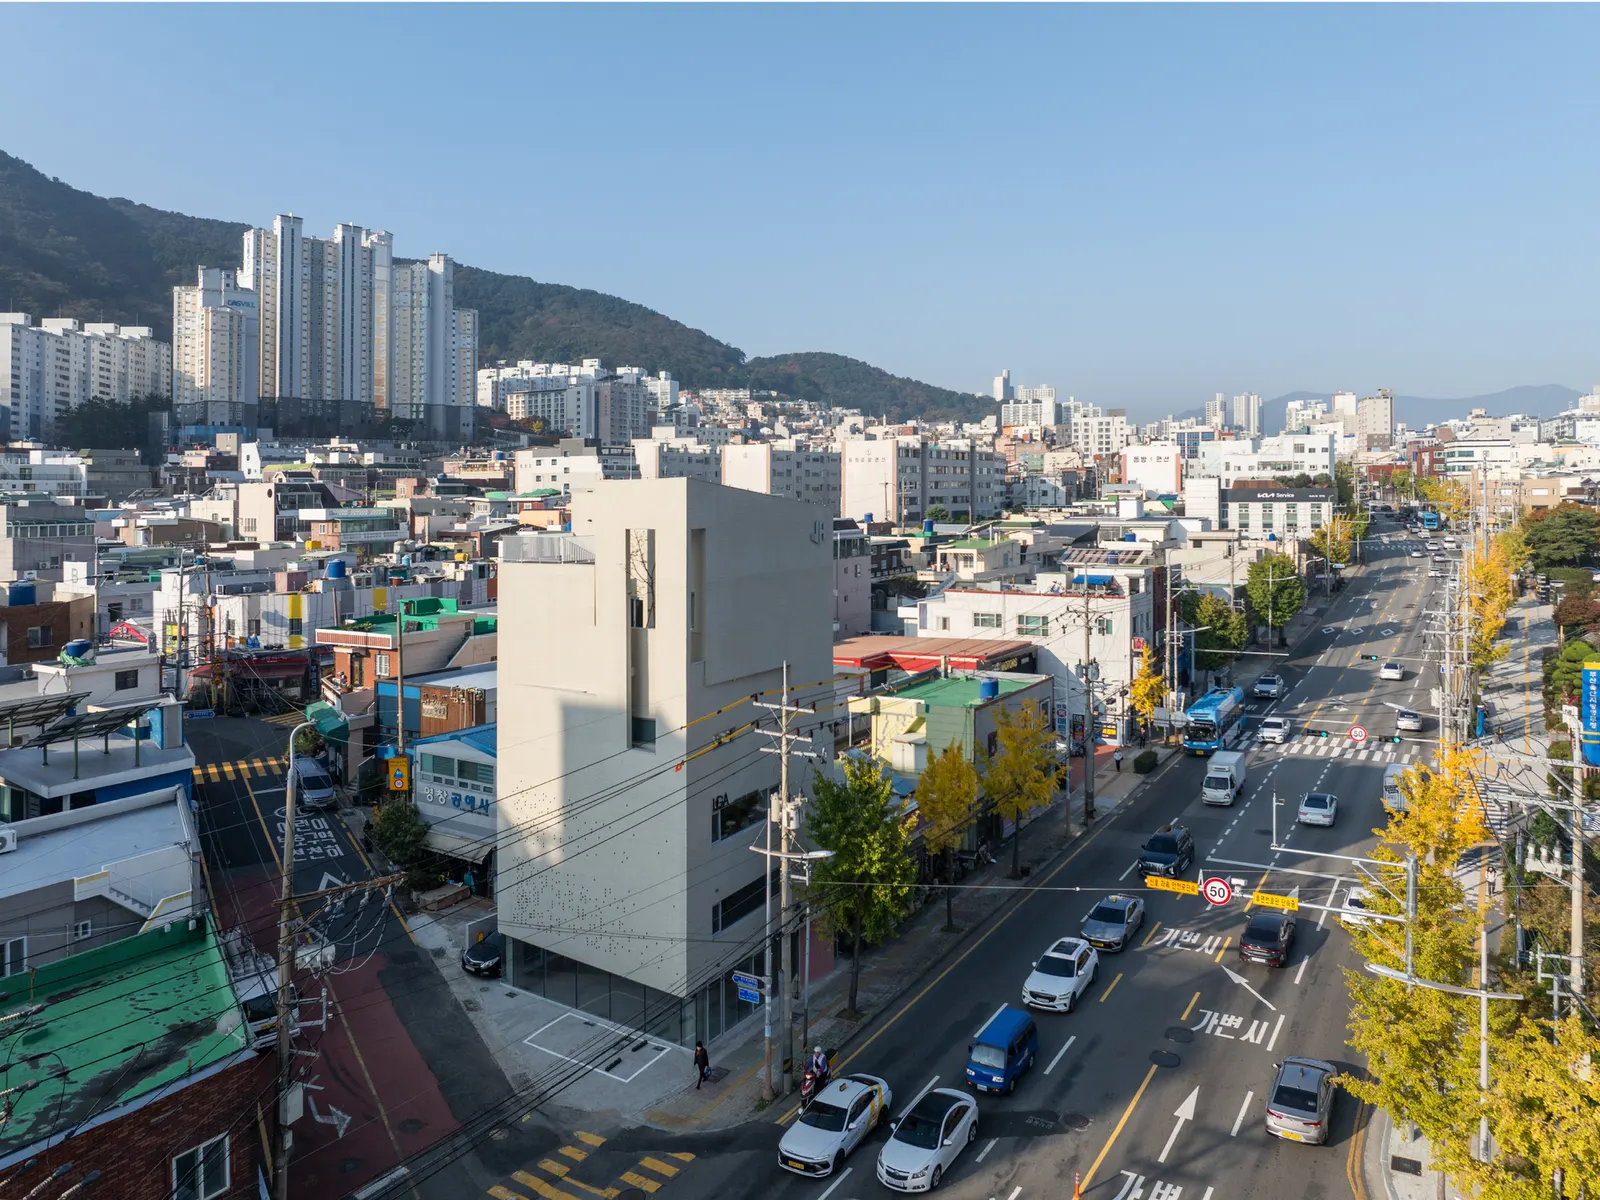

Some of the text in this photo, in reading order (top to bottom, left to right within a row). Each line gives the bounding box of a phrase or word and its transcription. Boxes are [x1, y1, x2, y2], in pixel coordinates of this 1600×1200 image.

[71, 568, 79, 583] B
[172, 577, 180, 591] A
[1353, 730, 1364, 738] 50
[424, 786, 448, 805] 영창
[451, 792, 489, 813] 공예사
[1209, 886, 1226, 899] 50
